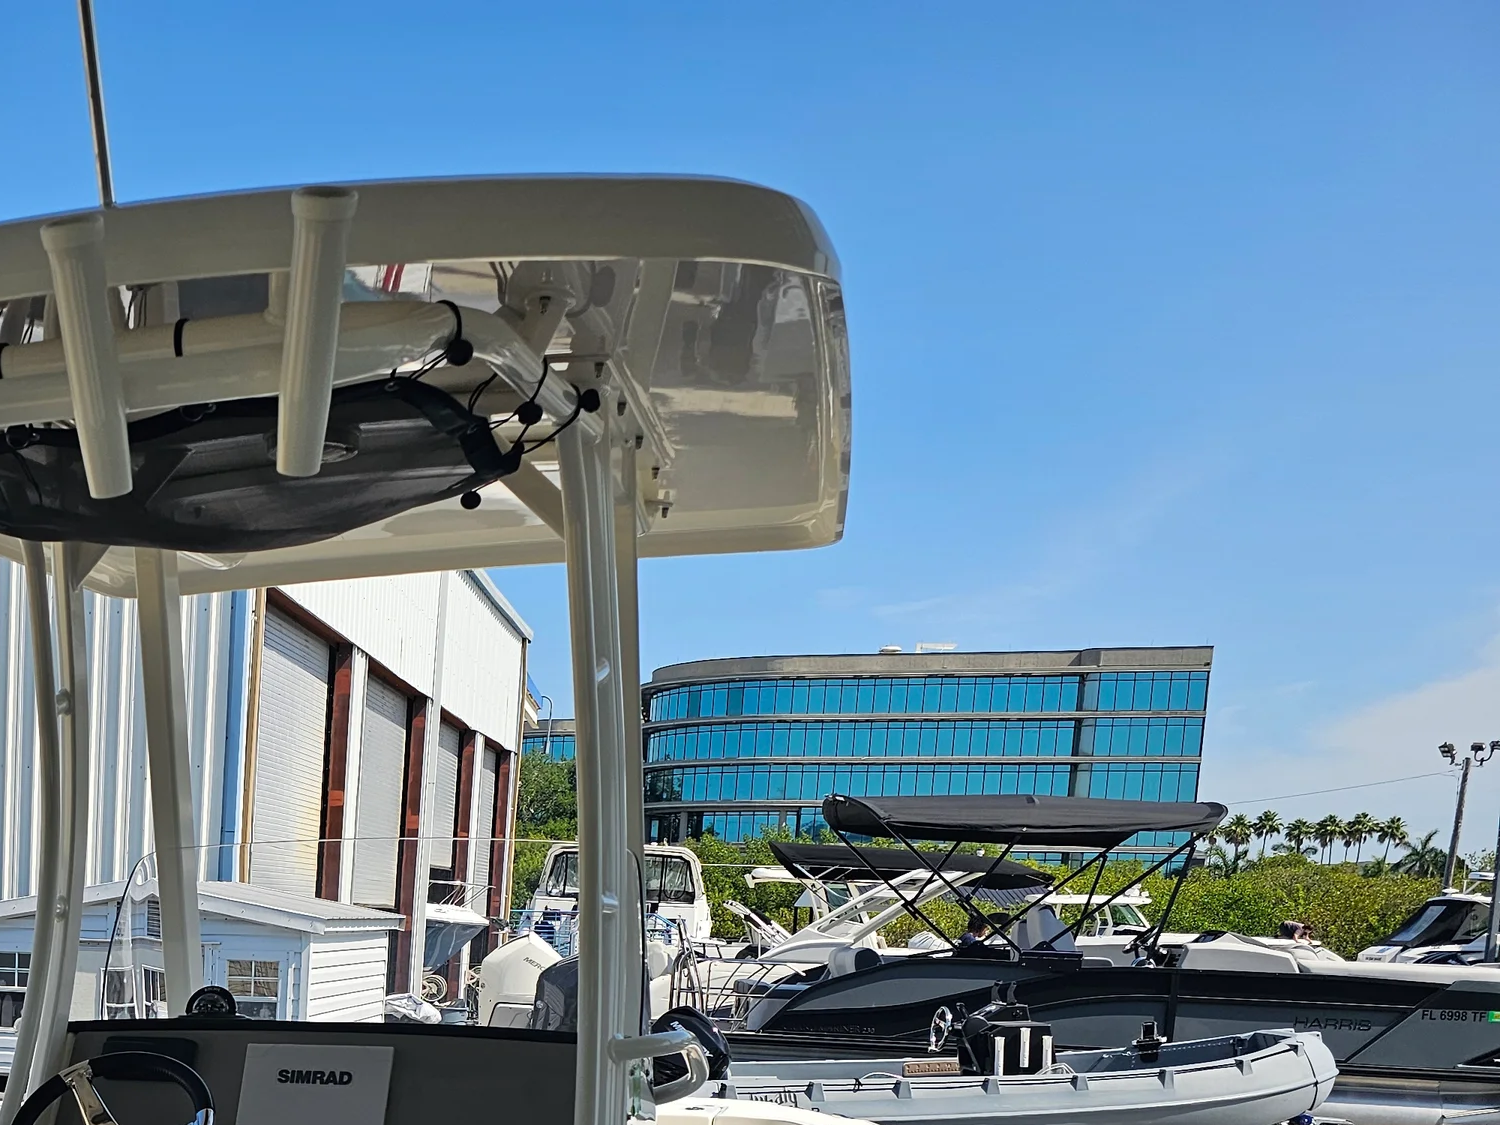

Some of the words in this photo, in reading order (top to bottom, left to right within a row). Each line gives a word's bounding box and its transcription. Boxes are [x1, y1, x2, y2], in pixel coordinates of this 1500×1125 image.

[1421, 1009, 1437, 1021] FL
[1440, 1010, 1468, 1022] 6998
[1471, 1011, 1487, 1022] TF
[1293, 1016, 1372, 1032] HARRIS
[277, 1069, 353, 1086] SIMRAD
